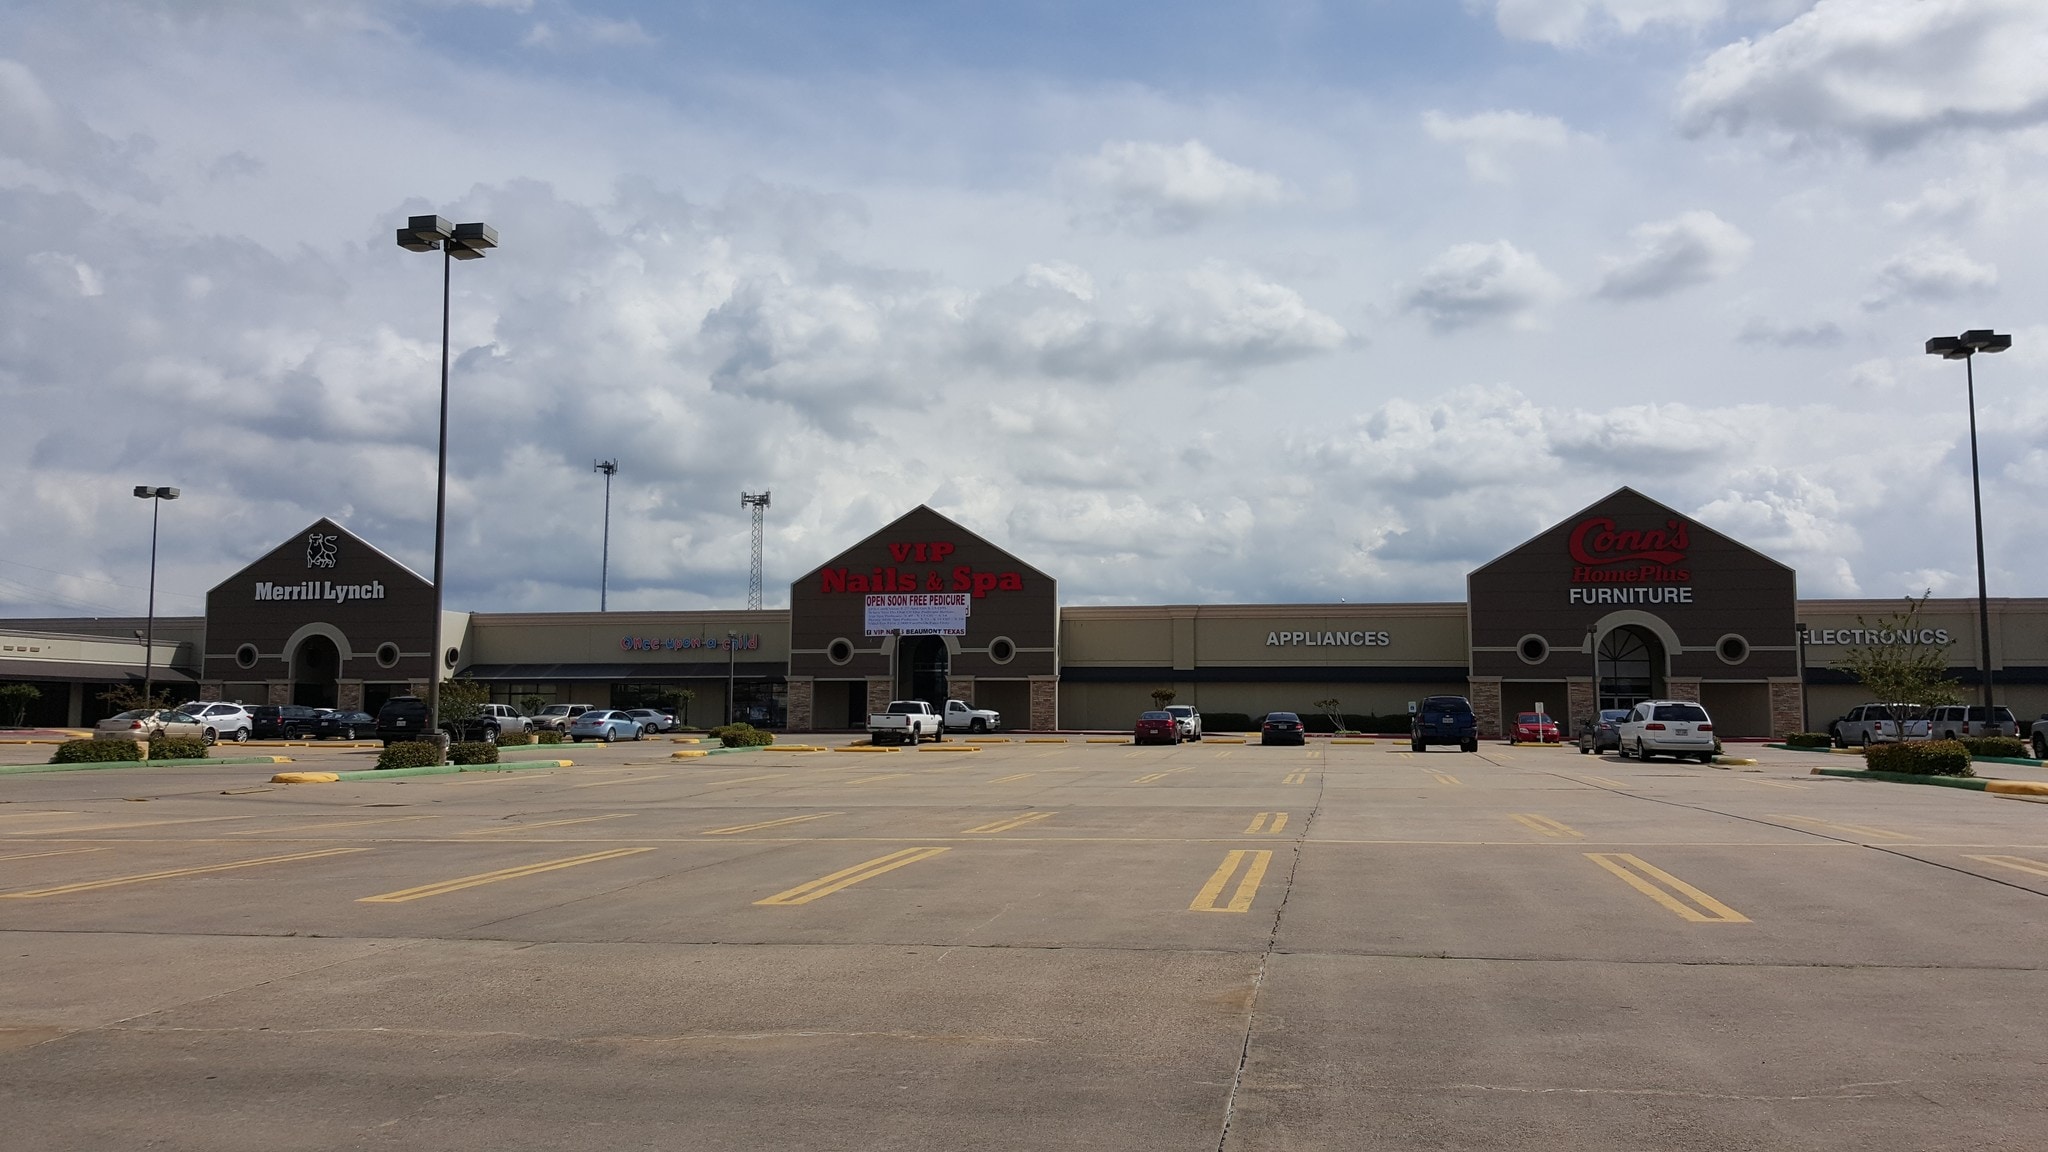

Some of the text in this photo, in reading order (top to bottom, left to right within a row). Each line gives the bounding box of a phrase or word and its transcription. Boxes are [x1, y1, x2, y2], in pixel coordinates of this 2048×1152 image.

[1569, 517, 1690, 565] Conn's
[888, 542, 955, 563] VIP
[820, 566, 1023, 598] Nails & Spa
[1571, 566, 1691, 583] HomePlus
[255, 580, 385, 604] Merrill Lynch
[866, 594, 966, 607] OPEN SOON FREE PEDICURE
[1569, 587, 1693, 604] FURNITURE
[620, 635, 660, 651] Once
[665, 637, 701, 651] upon
[706, 638, 717, 649] a
[1265, 631, 1390, 646] APPLIANCES
